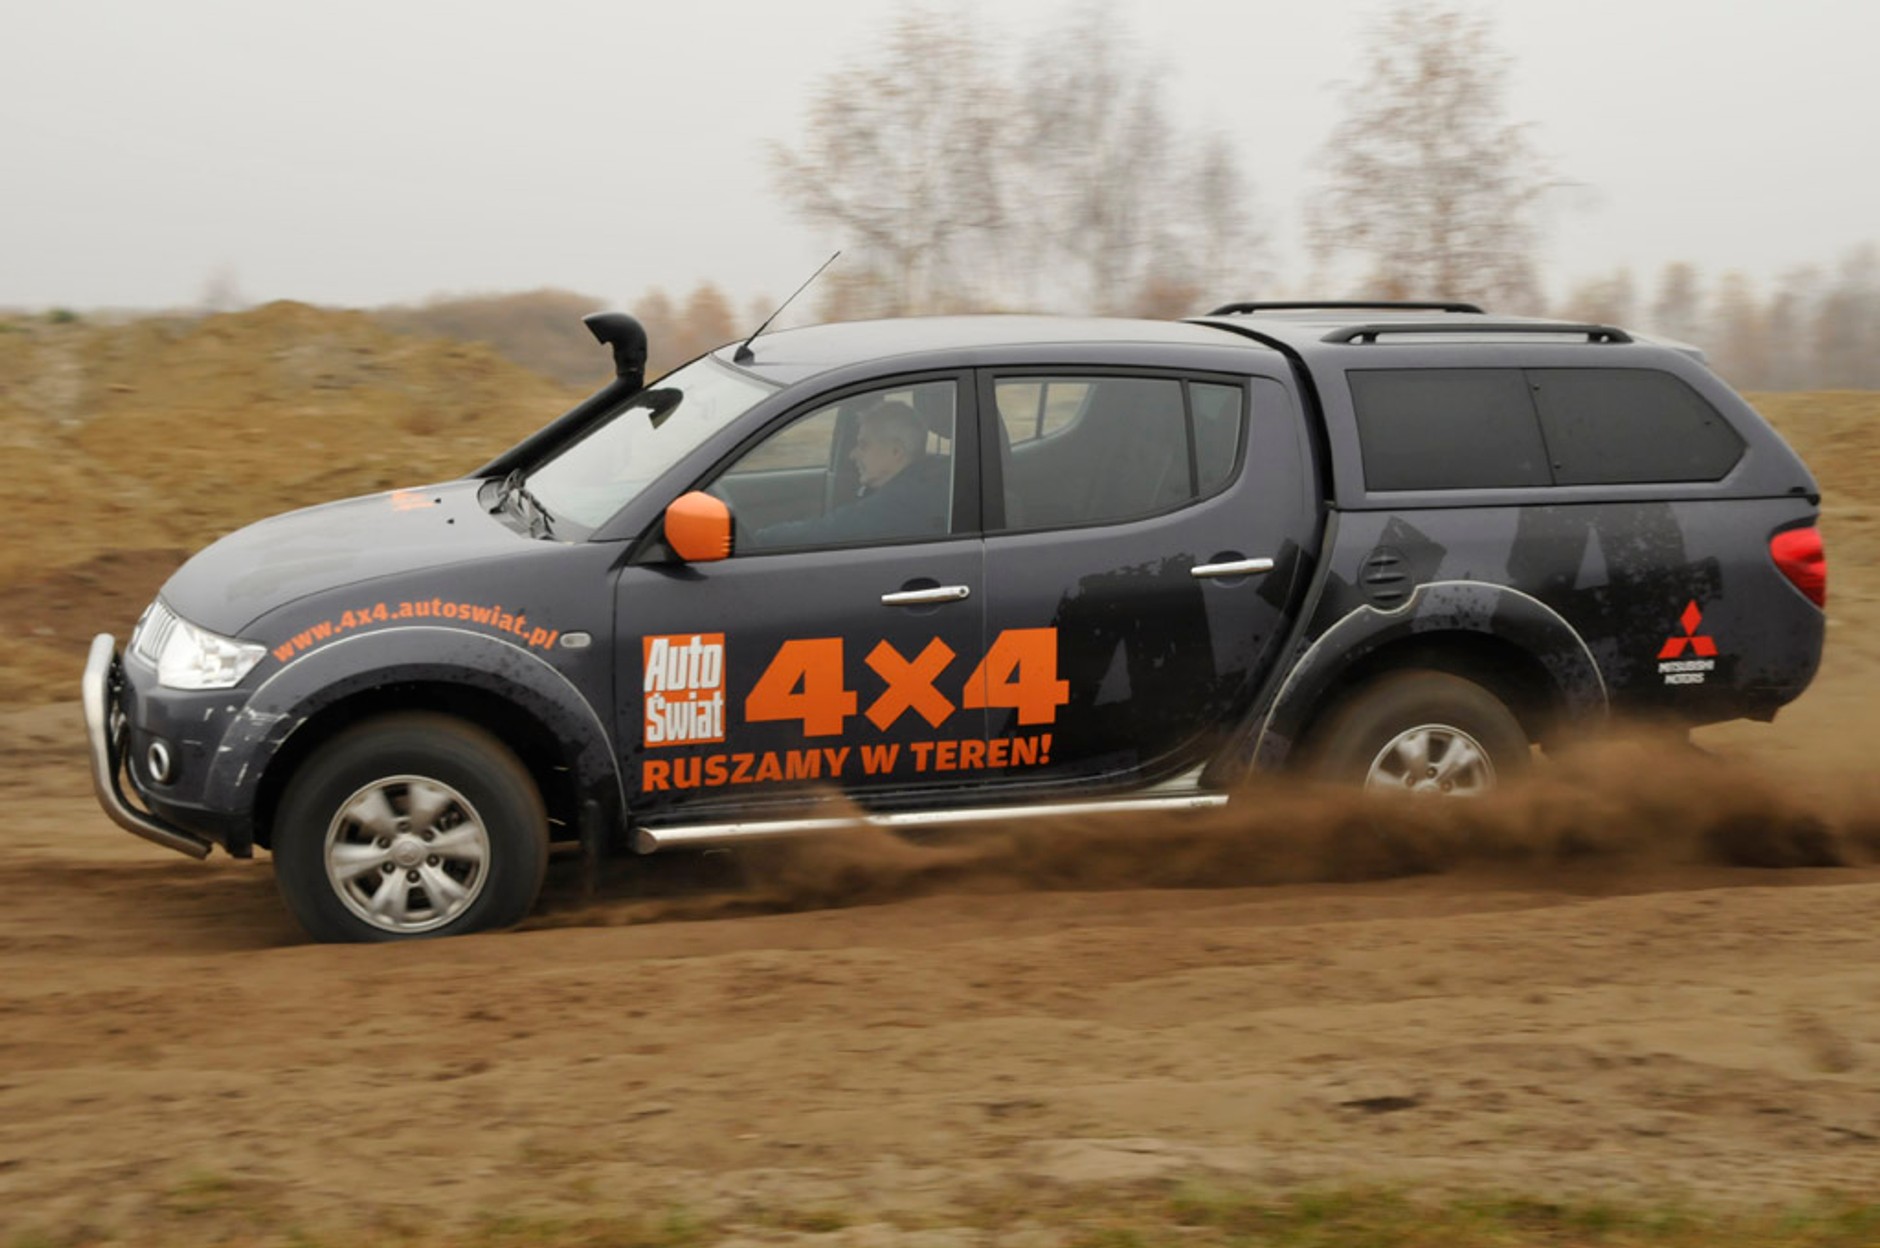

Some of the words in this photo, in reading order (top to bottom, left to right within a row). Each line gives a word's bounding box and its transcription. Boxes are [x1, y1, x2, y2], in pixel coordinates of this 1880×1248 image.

[273, 598, 559, 662] www.4x4.autoswiat.pl
[644, 635, 722, 692] Auto
[745, 627, 1070, 737] 4x4
[645, 691, 723, 743] Świat
[642, 746, 850, 792] RUSZAMY
[860, 743, 900, 774] W
[910, 733, 1053, 772] TEREN!
